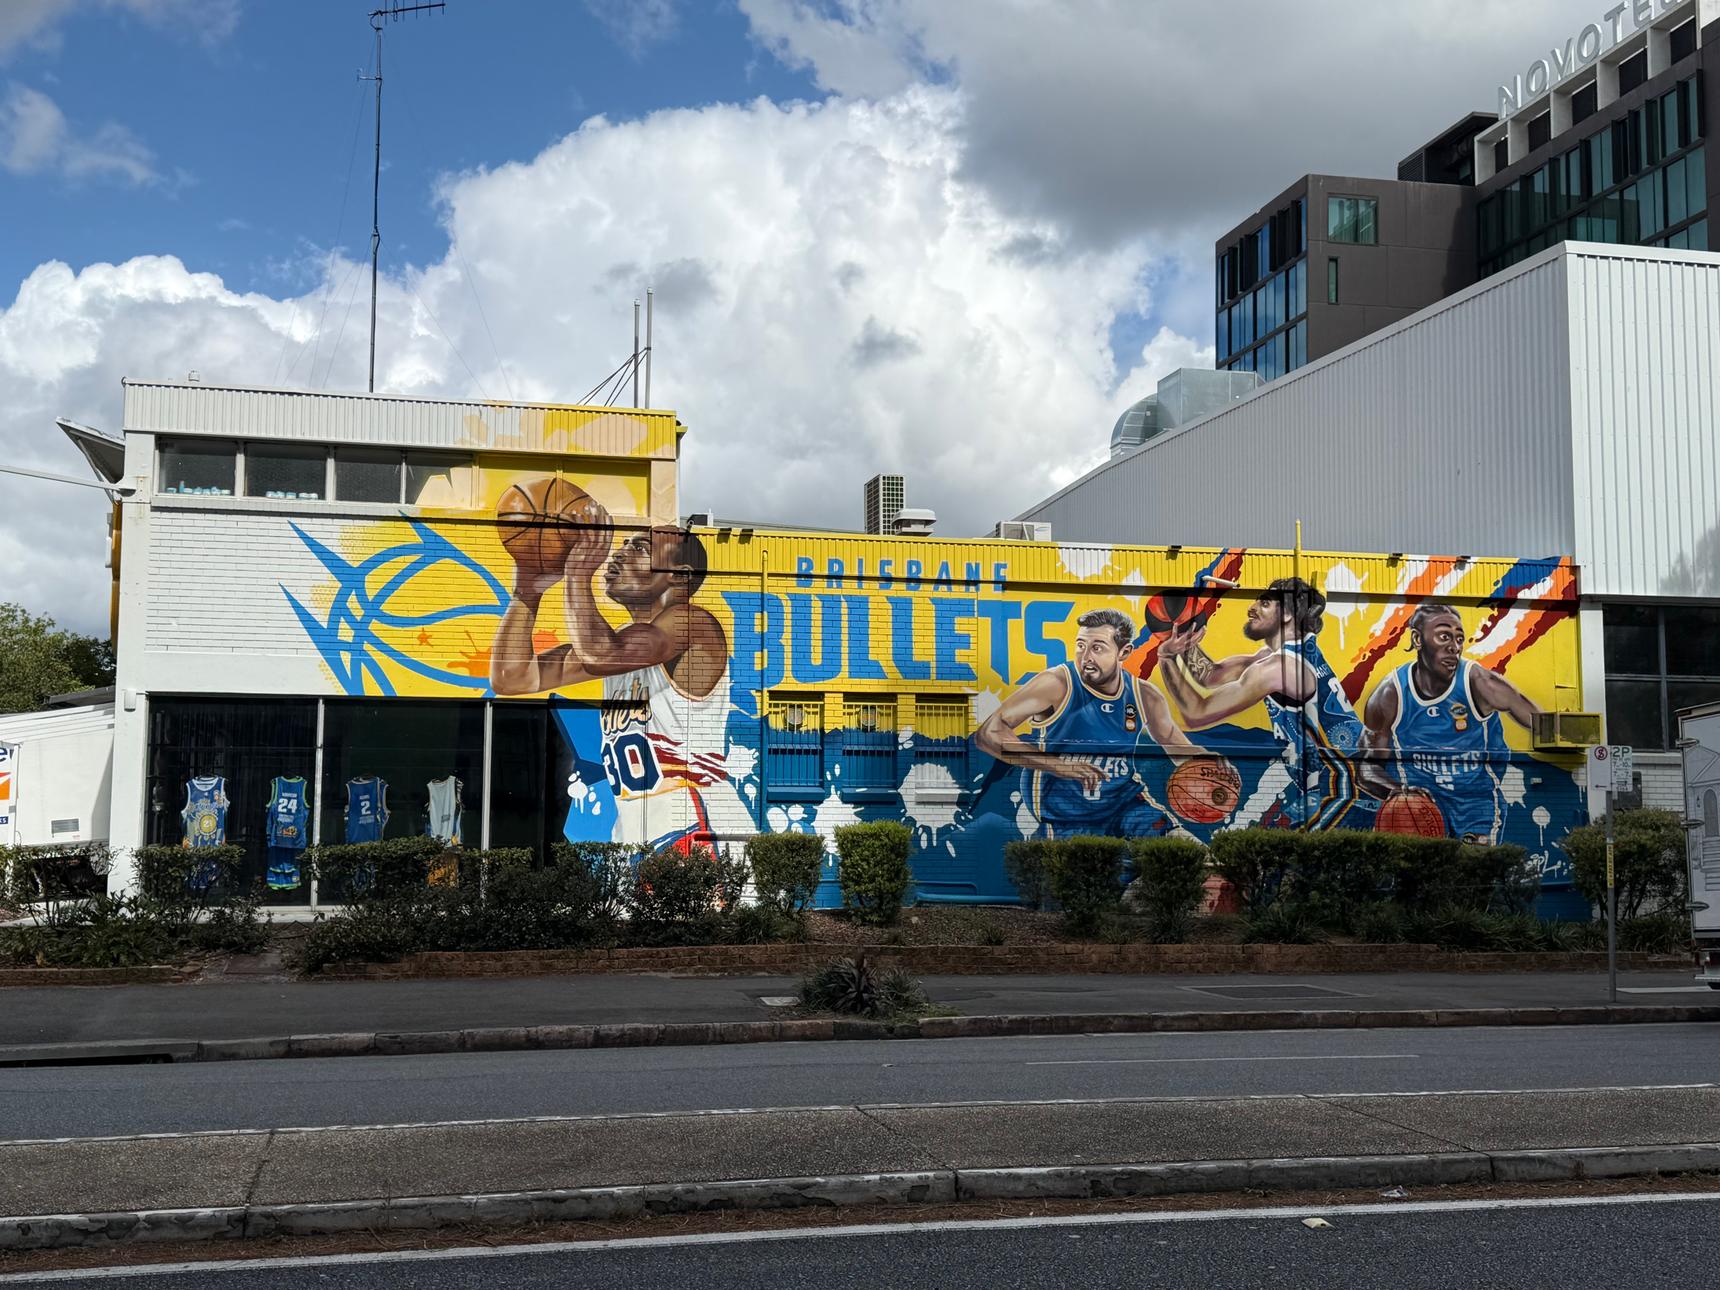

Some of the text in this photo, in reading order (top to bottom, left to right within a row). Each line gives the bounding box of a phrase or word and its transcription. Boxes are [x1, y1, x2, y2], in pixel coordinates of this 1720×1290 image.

[1497, 0, 1682, 118] NOVOTE
[796, 556, 1009, 593] BRISBANE
[720, 590, 1075, 690] BULLETS
[1612, 746, 1630, 757] 2P
[277, 798, 298, 814] 24
[360, 800, 371, 816] 2
